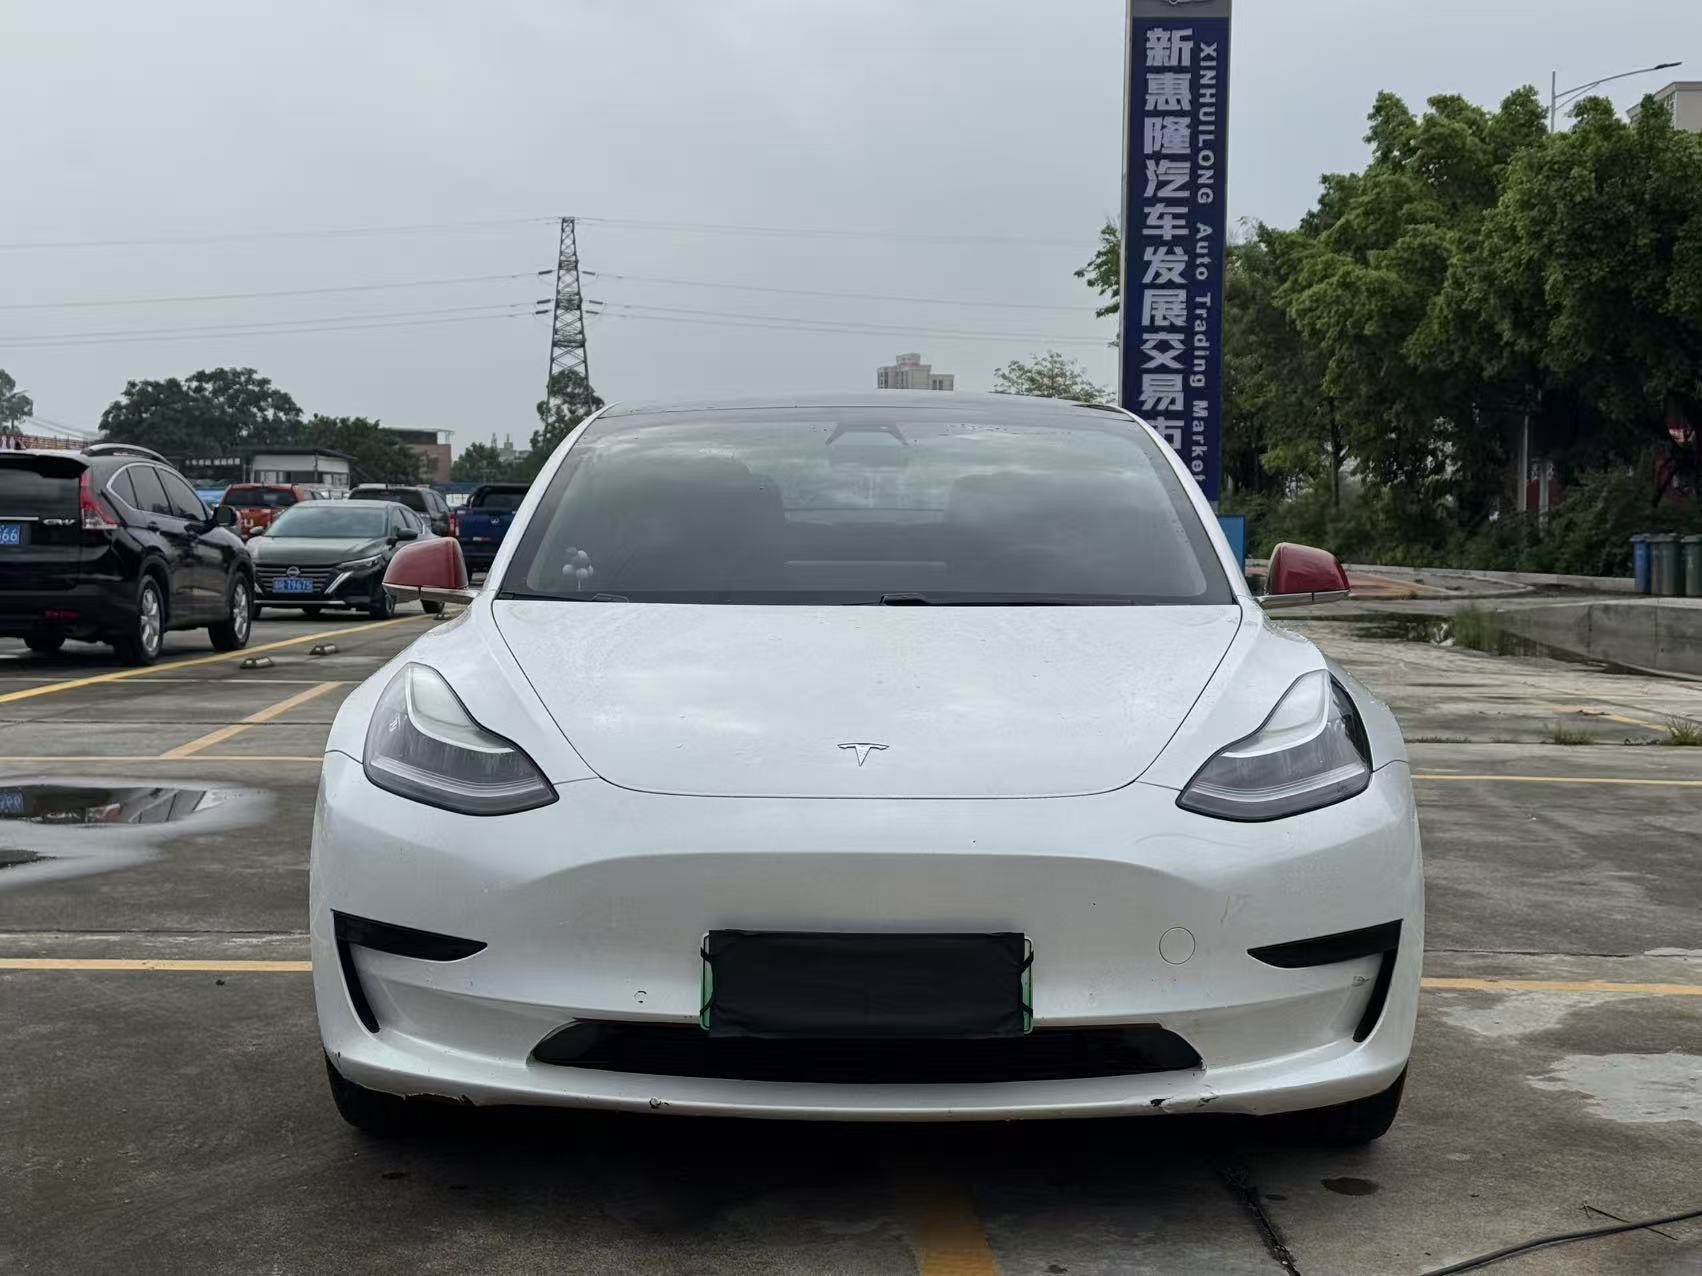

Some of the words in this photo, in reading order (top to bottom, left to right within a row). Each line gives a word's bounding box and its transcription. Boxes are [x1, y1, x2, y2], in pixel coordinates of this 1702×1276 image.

[1197, 42, 1217, 204] XINHUILONG
[1195, 222, 1213, 280] Auto
[1190, 292, 1211, 387] Trading
[0, 528, 17, 541] 66
